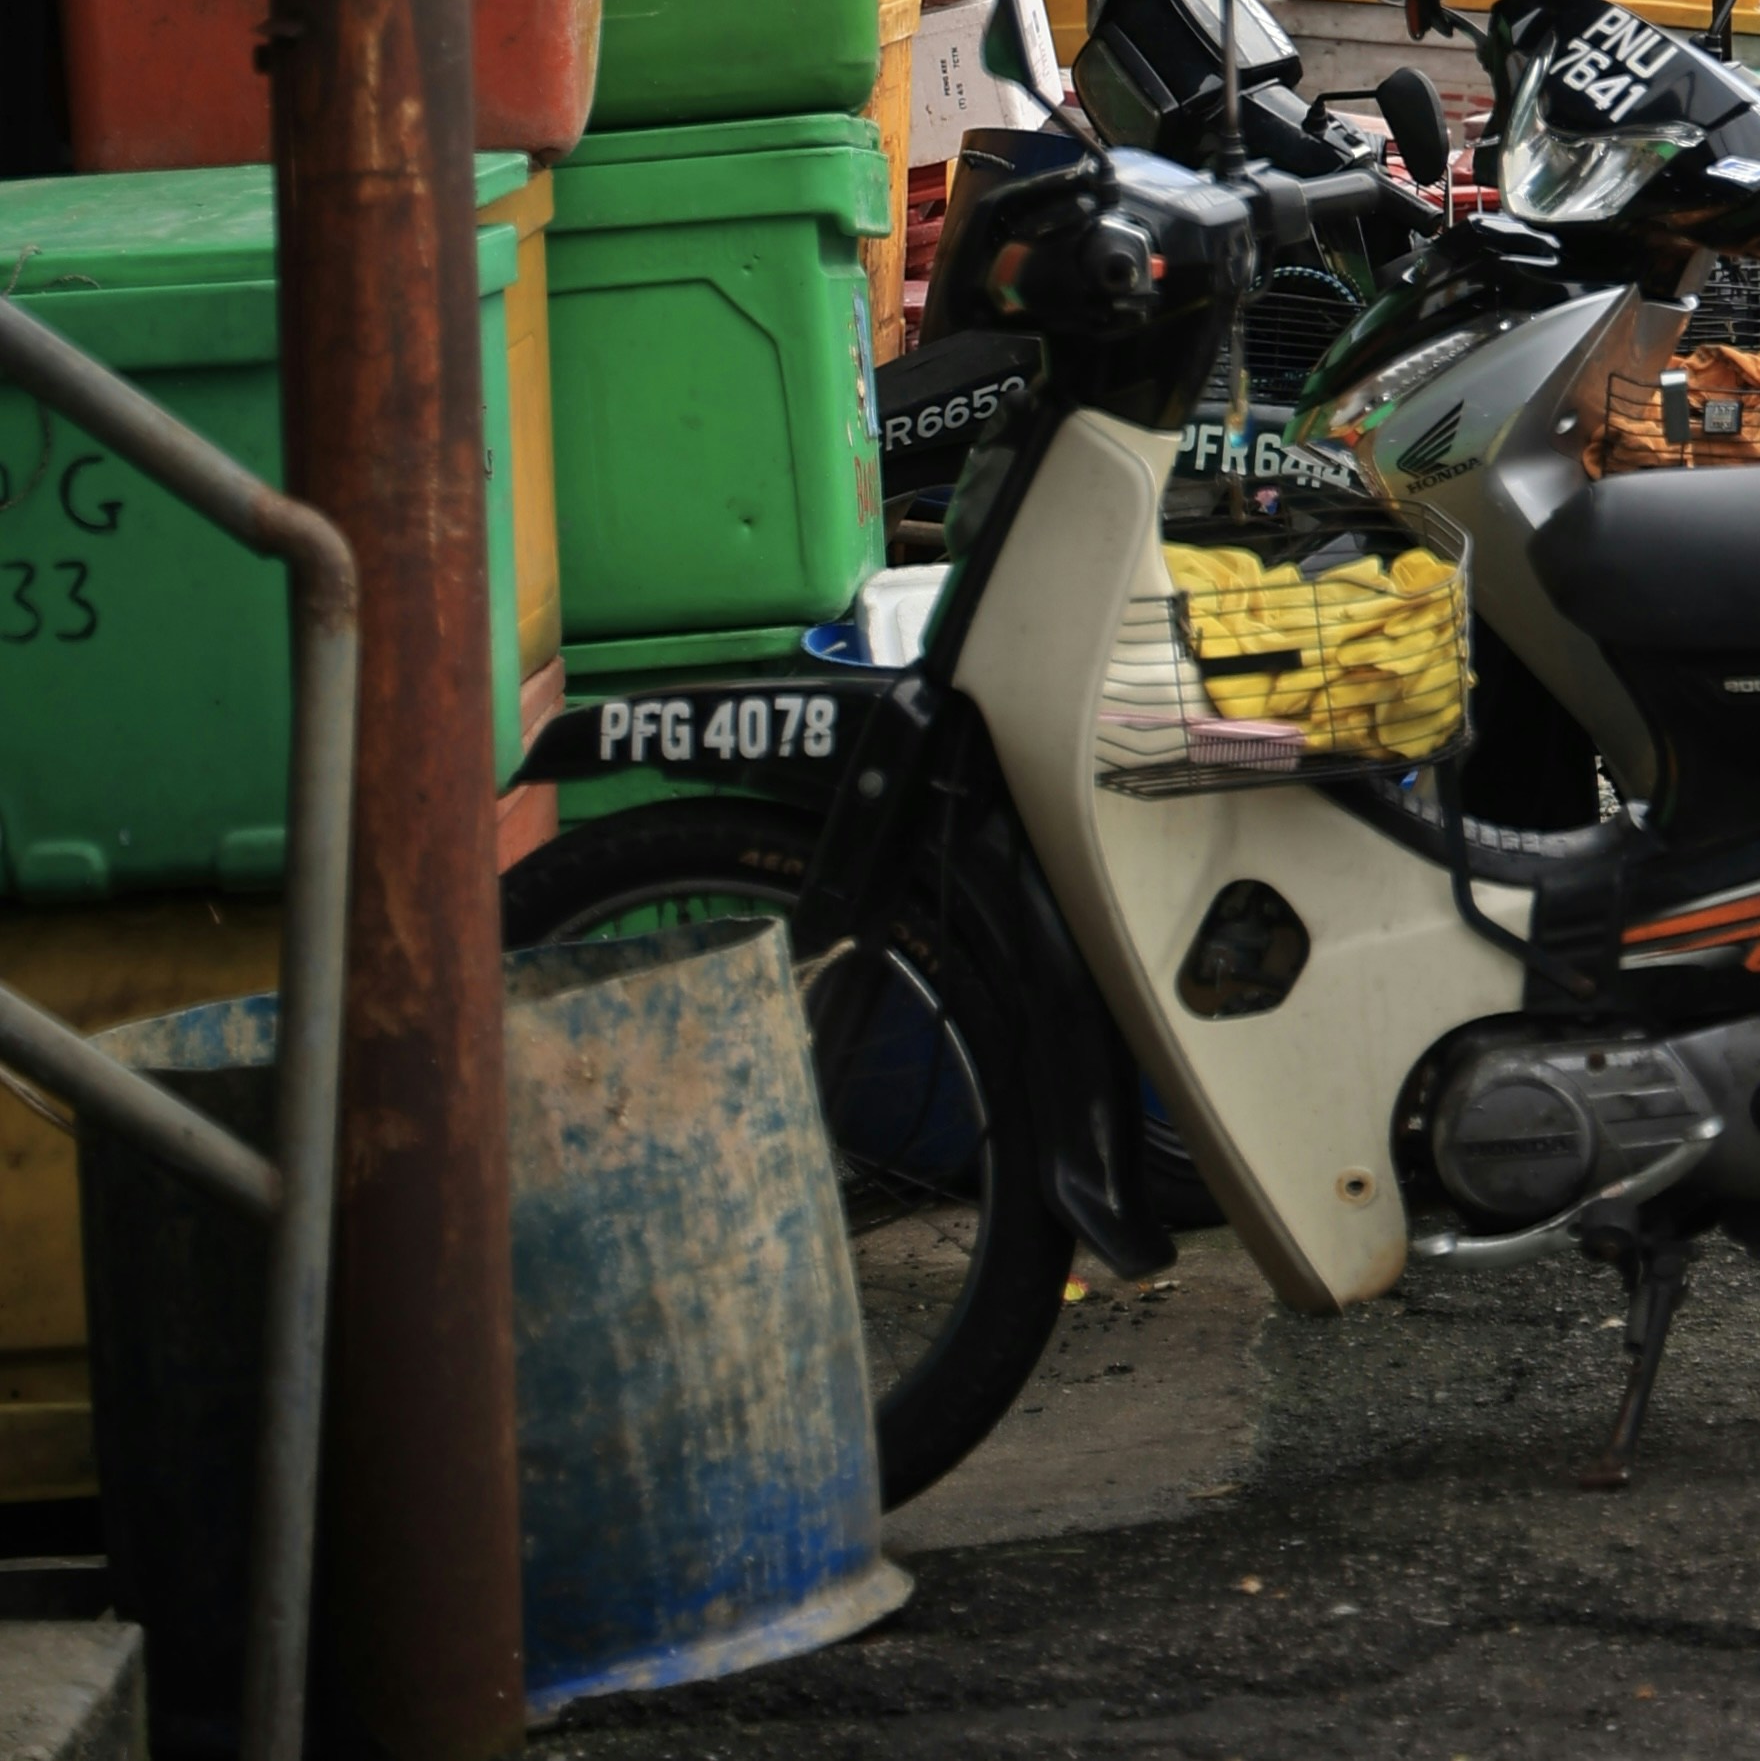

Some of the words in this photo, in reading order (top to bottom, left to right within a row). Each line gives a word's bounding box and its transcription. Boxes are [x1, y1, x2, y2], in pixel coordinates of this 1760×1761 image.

[1583, 7, 1679, 79] PNU
[1550, 39, 1648, 123] 7641
[1406, 457, 1482, 495] HONDA
[601, 699, 691, 762] PFG
[703, 696, 836, 760] 4078
